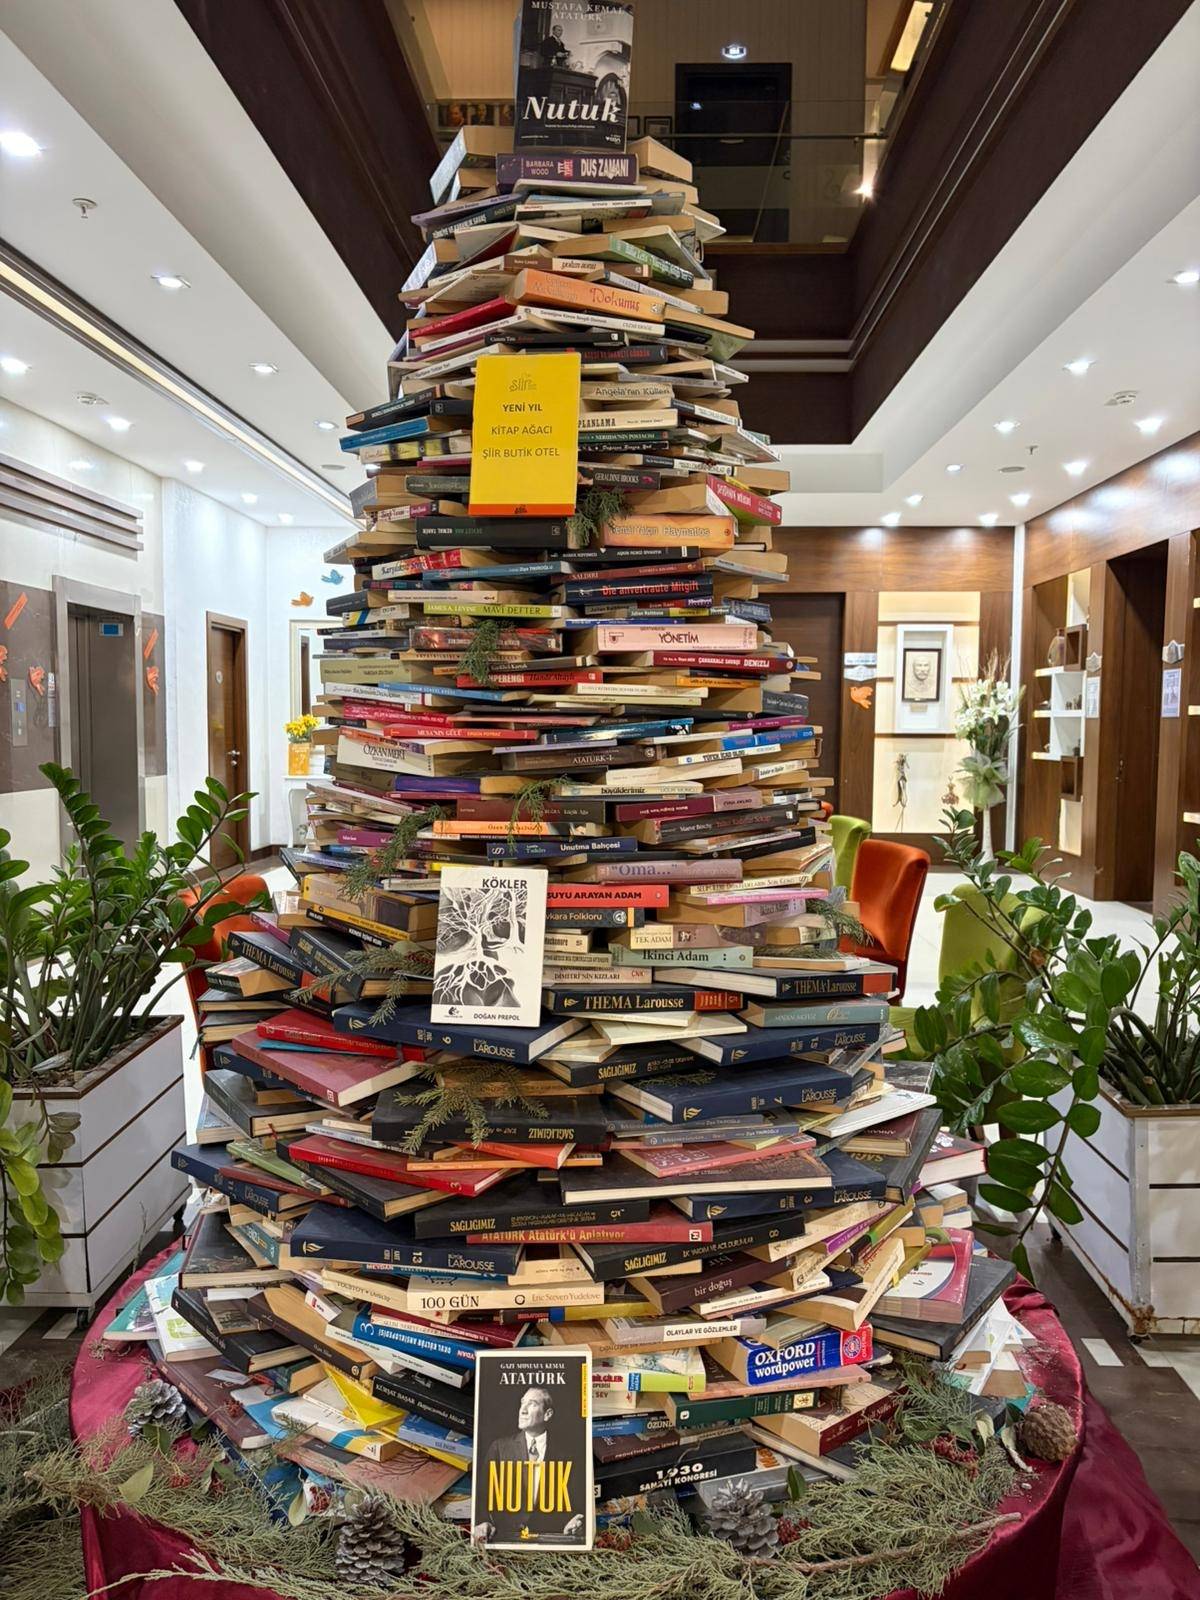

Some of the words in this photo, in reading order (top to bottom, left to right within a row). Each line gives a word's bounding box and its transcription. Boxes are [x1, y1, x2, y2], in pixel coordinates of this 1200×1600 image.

[531, 1, 583, 11] MUSTAFA
[587, 4, 625, 14] KEMAL
[523, 96, 621, 122] Nutuk
[525, 160, 554, 168] BARBARA
[598, 158, 629, 178] ZAMANI
[530, 168, 549, 176] WOOD
[503, 402, 526, 412] YENİ
[528, 403, 542, 412] YIL
[491, 425, 519, 436] KİTAP
[523, 424, 552, 434] AĞACI
[482, 449, 501, 459] ŞİİR
[503, 448, 532, 458] BUTİK
[535, 447, 560, 457] OTEL
[602, 587, 617, 596] Die
[619, 583, 669, 595] anvertraute
[671, 579, 699, 593] Mitgift
[483, 605, 503, 614] MAVİ
[505, 606, 542, 615] DEFTER
[658, 631, 699, 644] YÖNETİM
[388, 746, 406, 760] MERT
[601, 786, 645, 795] büyüklerimiz
[560, 843, 590, 852] Unutma
[591, 841, 620, 851] Bahçesi
[482, 876, 527, 890] KÖKLER
[574, 891, 613, 900] ARAYAN
[614, 891, 642, 900] ADAM
[569, 912, 602, 921] Folkloru
[635, 936, 650, 944] TEK
[651, 936, 672, 944] ADAM
[241, 940, 268, 963] THEMA
[268, 955, 297, 980] Larousse
[676, 950, 709, 962] Adam
[794, 979, 824, 994] THEMA
[827, 979, 857, 993] Larousse
[584, 995, 632, 1010] THEMA
[636, 994, 684, 1009] Larousse
[473, 1012, 497, 1021] DOĞAN
[497, 1013, 521, 1021] PREPOL
[834, 1032, 866, 1046] LAROUSSE
[473, 1044, 515, 1058] LAROUSSE
[802, 1089, 837, 1103] LAROUSSE
[833, 1191, 872, 1204] LAROUSSE
[529, 1228, 576, 1241] Atatürk'ü
[579, 1229, 626, 1241] Anlatıyor
[448, 1258, 495, 1271] LAROUSSE
[694, 1287, 706, 1297] bir
[708, 1277, 733, 1294] doğuş
[421, 1296, 446, 1309] 100
[449, 1294, 480, 1308] GÜN
[666, 1326, 693, 1337] OLAYLAR
[694, 1326, 702, 1335] VE
[703, 1324, 738, 1334] GÖZLEMLER
[755, 1342, 815, 1366] OXFORD
[755, 1357, 815, 1378] wordpower
[499, 1370, 566, 1385] ATATÜRK
[656, 1463, 703, 1480] 1930
[674, 1469, 717, 1485] KONGRESİ
[488, 1460, 573, 1513] NUTUK
